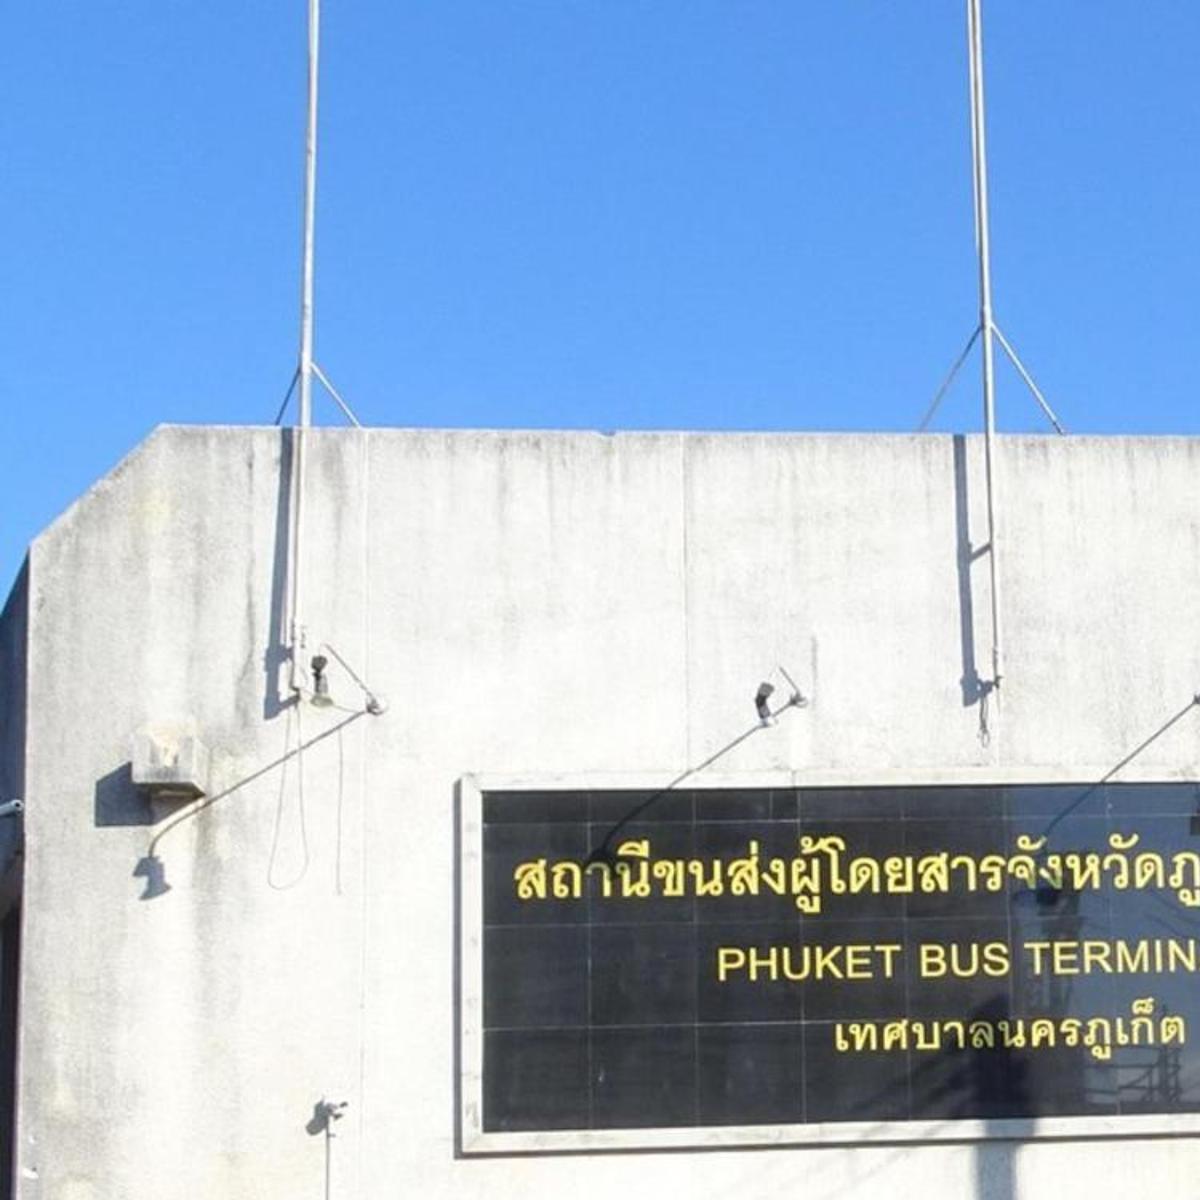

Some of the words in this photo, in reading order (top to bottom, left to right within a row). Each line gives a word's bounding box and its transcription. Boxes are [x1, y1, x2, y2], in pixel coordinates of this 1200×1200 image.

[717, 945, 902, 982] PHUKET
[919, 942, 1009, 977] BUS
[835, 997, 1186, 1060] เทศบาลนครภูเก็ต
